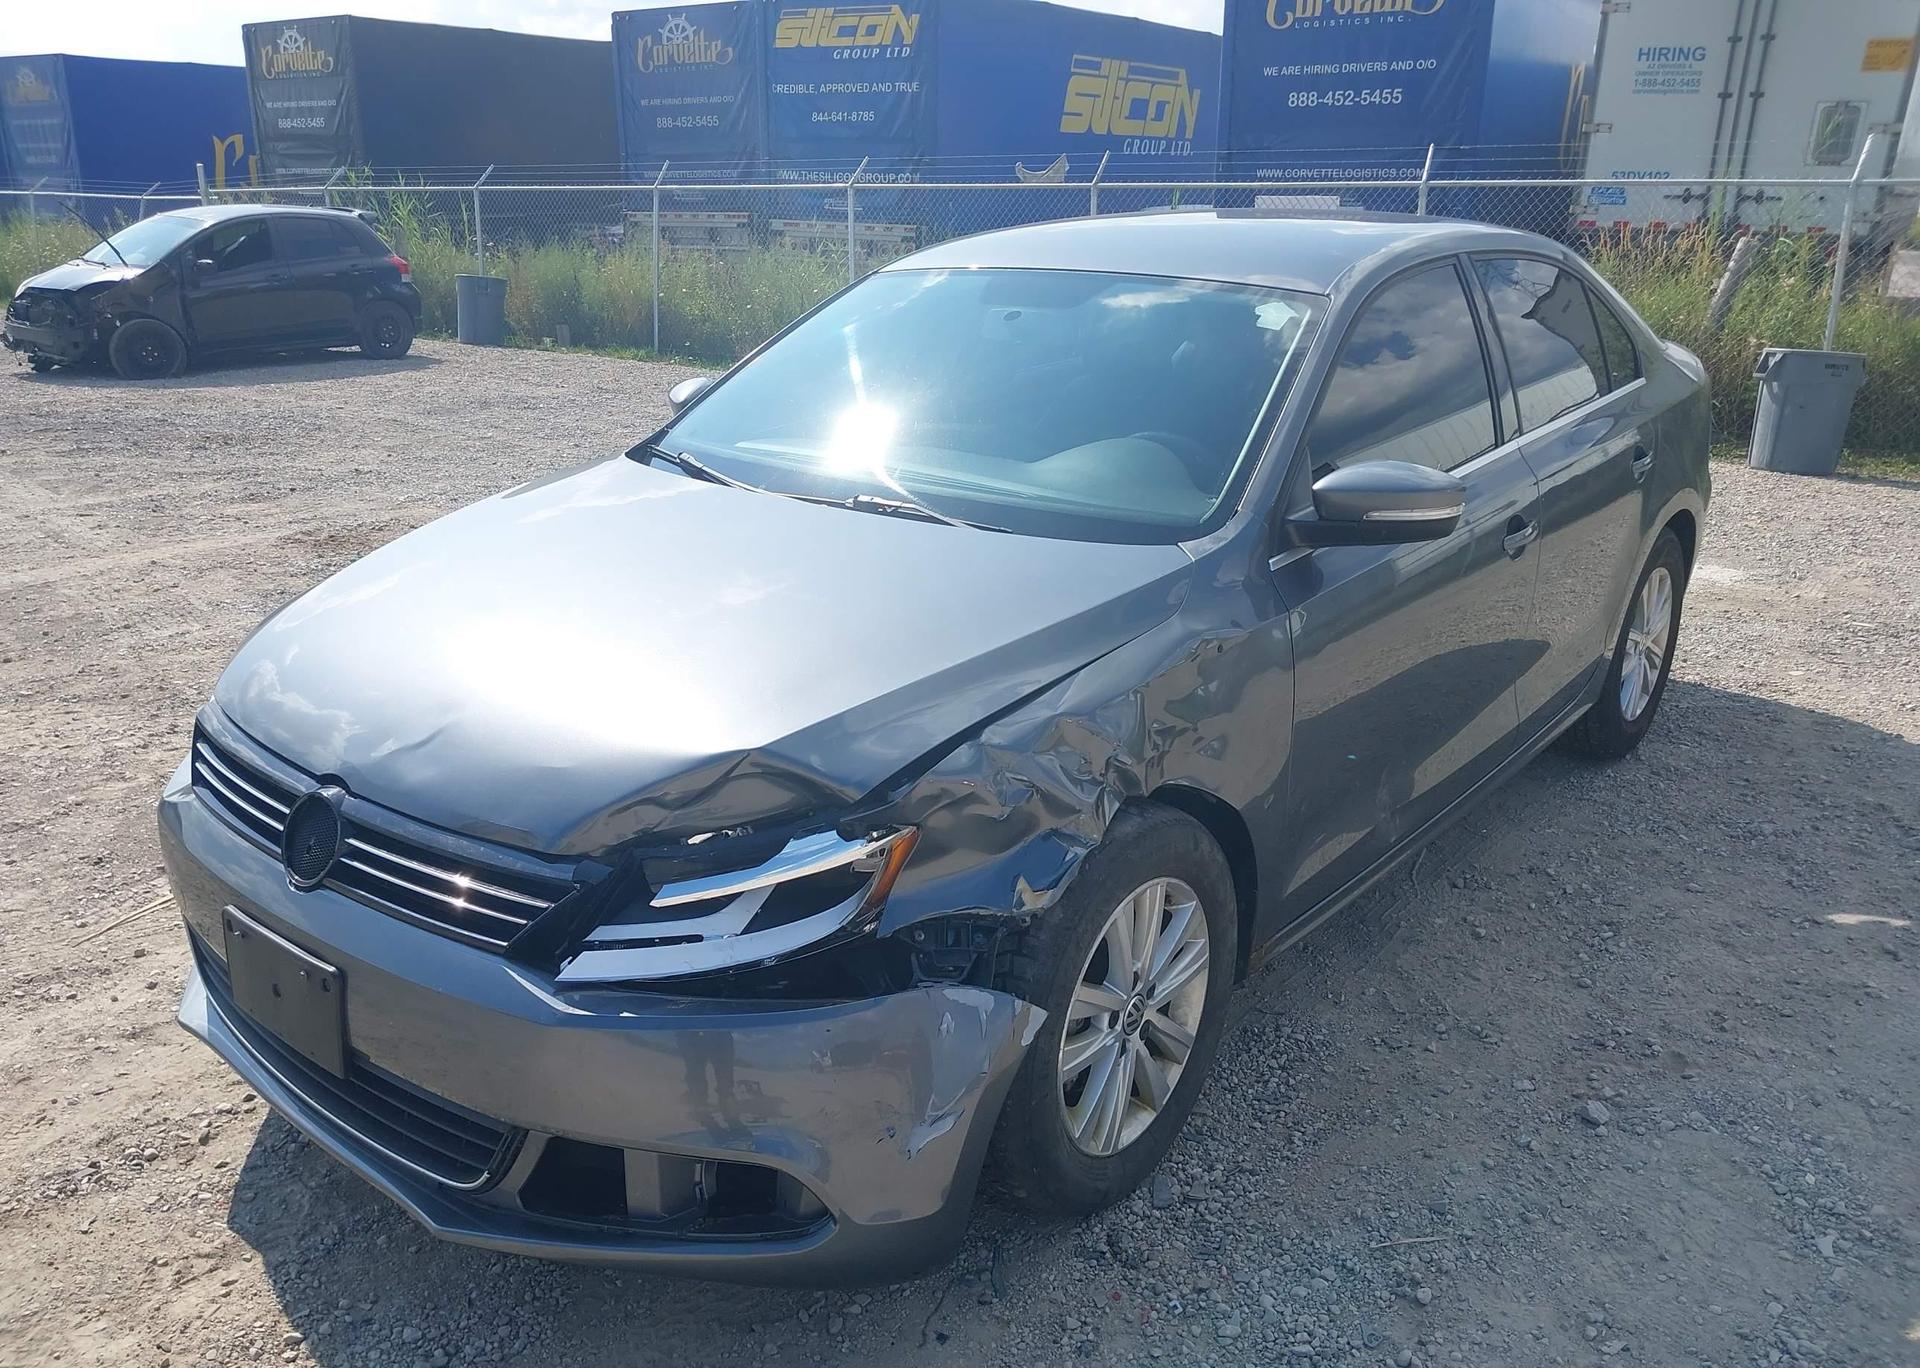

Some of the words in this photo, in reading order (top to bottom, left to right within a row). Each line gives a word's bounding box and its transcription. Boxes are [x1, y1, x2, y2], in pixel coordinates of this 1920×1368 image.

[1295, 17, 1370, 29] LOGISTICS
[1380, 15, 1411, 23] INC.
[637, 28, 733, 73] Corvette
[833, 48, 880, 60] GROUP
[1637, 46, 1707, 62] HIRING
[261, 41, 334, 79] Corvette
[1263, 66, 1278, 77] WE
[1280, 65, 1301, 76] ARE
[1303, 63, 1340, 75] HIRING
[1341, 61, 1388, 74] DRIVERS
[1390, 60, 1414, 71] AND
[1416, 59, 1437, 70] O/O
[772, 83, 818, 95] CREDIBLE,
[819, 83, 870, 94] APPROVED
[872, 82, 893, 93] AND
[894, 82, 920, 92] TRUE
[1634, 78, 1702, 88] 1-888-452-5455
[683, 96, 708, 105] DRIVERS
[1288, 88, 1403, 108] 888-452-5455
[278, 117, 325, 129] 888-452-5455
[656, 115, 719, 128] 888-452-5455
[811, 111, 875, 122] 844-641-8785
[1123, 138, 1167, 155] GROUP
[1171, 140, 1194, 157] LTD.
